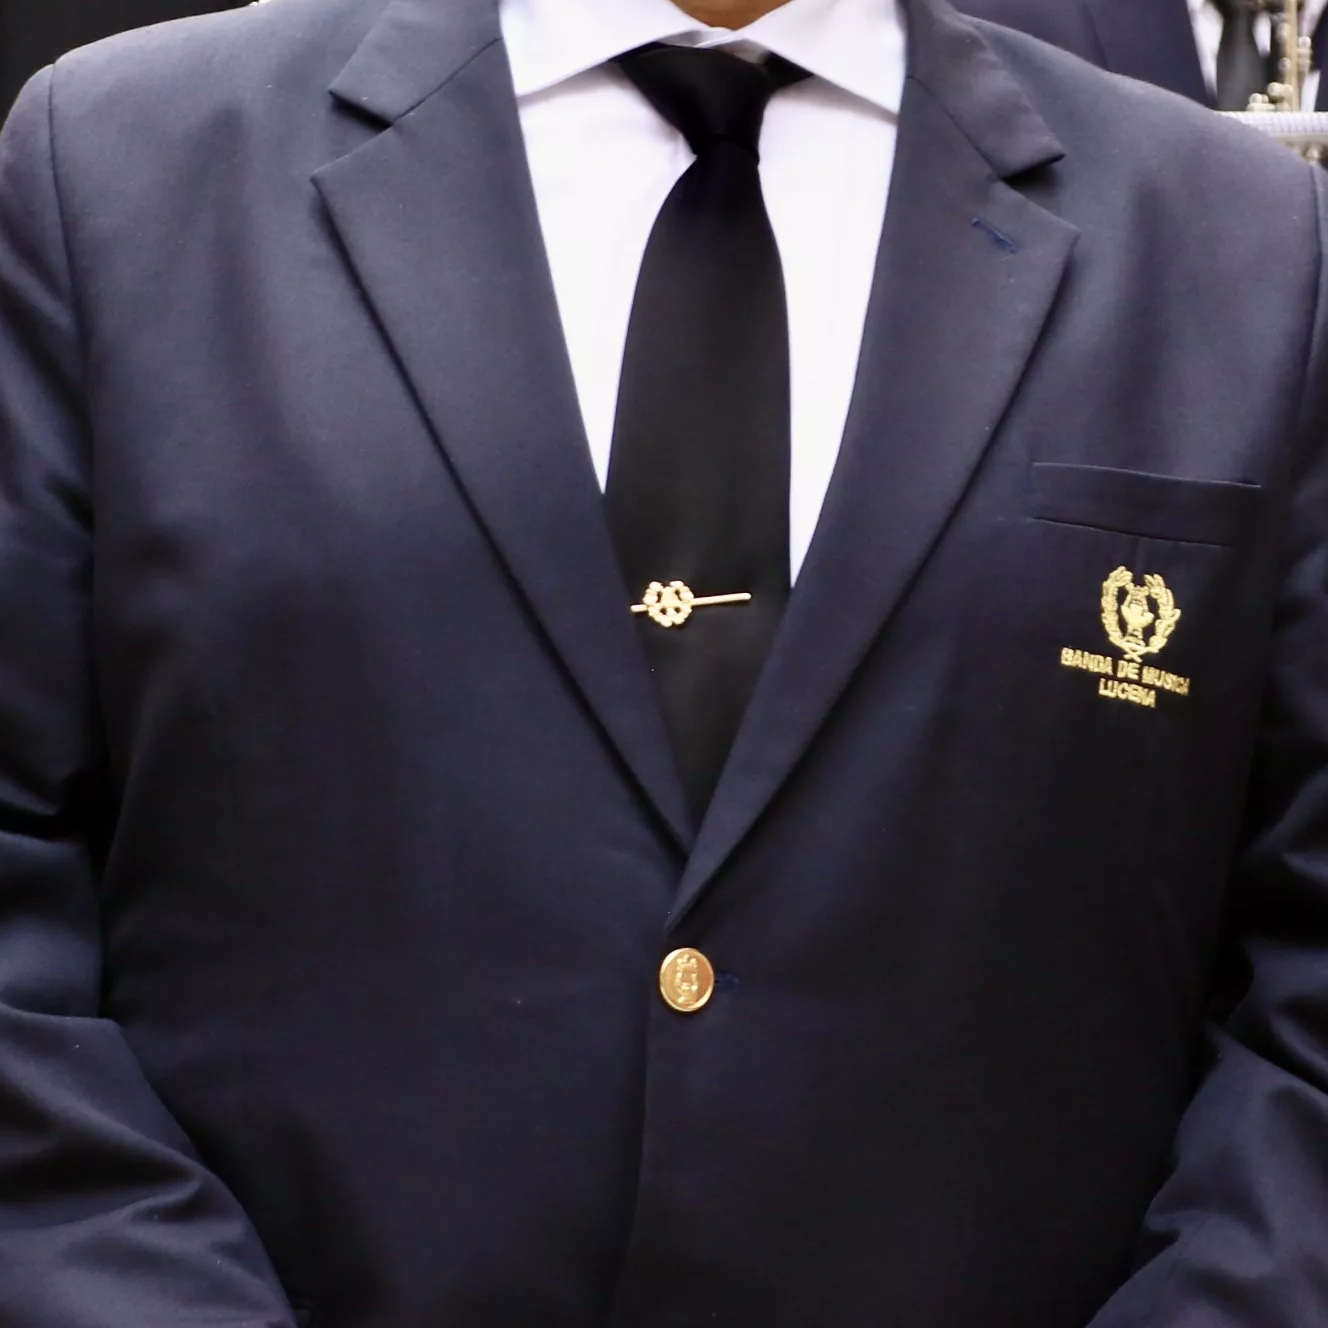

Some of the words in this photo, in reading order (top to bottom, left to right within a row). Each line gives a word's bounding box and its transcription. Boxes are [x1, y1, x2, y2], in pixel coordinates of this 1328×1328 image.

[1061, 647, 1113, 675] BANDA
[1117, 660, 1140, 680] DE
[1099, 678, 1156, 707] LUCENA
